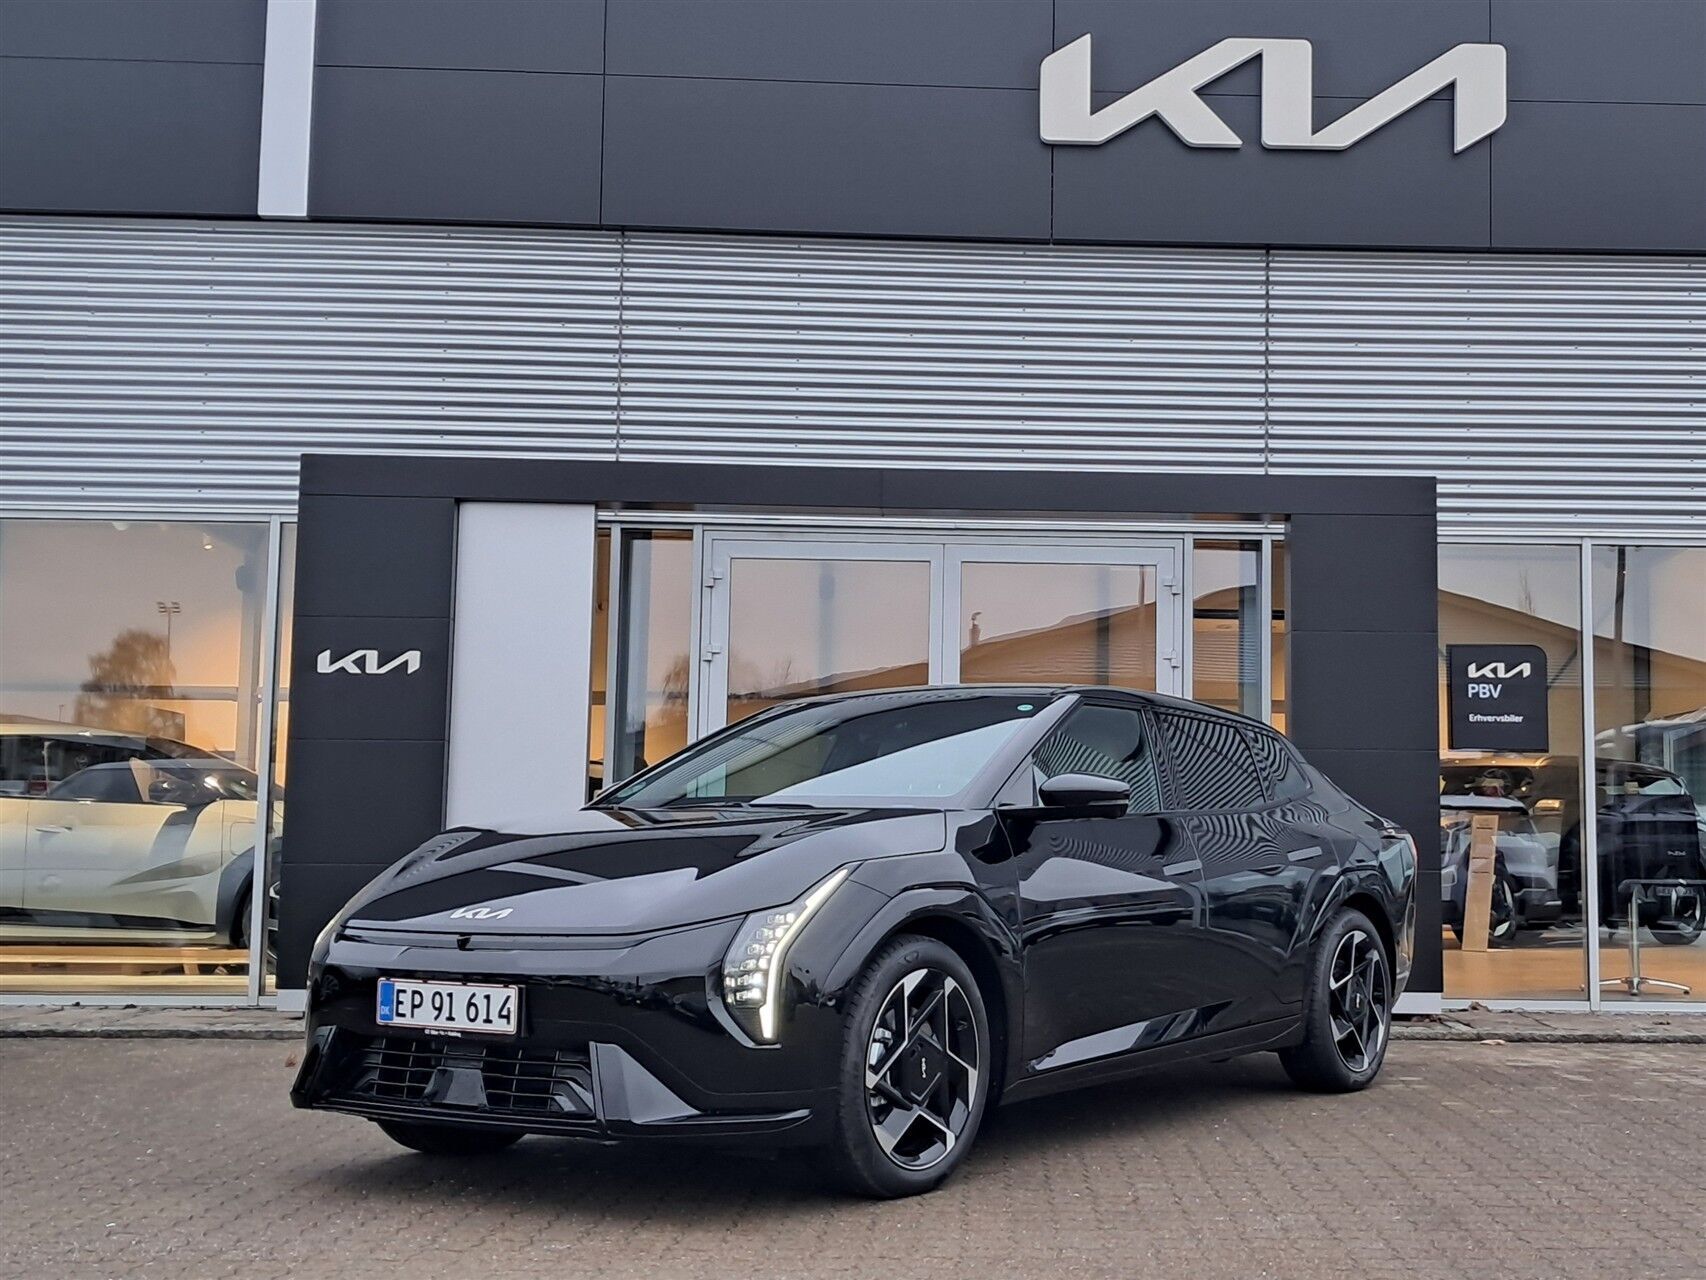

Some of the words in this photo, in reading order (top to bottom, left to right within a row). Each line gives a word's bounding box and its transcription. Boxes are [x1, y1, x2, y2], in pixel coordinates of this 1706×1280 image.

[1040, 33, 1507, 154] KIA
[317, 649, 421, 675] KIA
[1467, 662, 1531, 678] KIA
[1467, 683, 1502, 698] PBV
[1468, 713, 1523, 723] Erhvervsbiler
[450, 907, 514, 919] KIA
[395, 988, 424, 1019] EP
[431, 990, 456, 1022] 91
[466, 992, 512, 1026] 614
